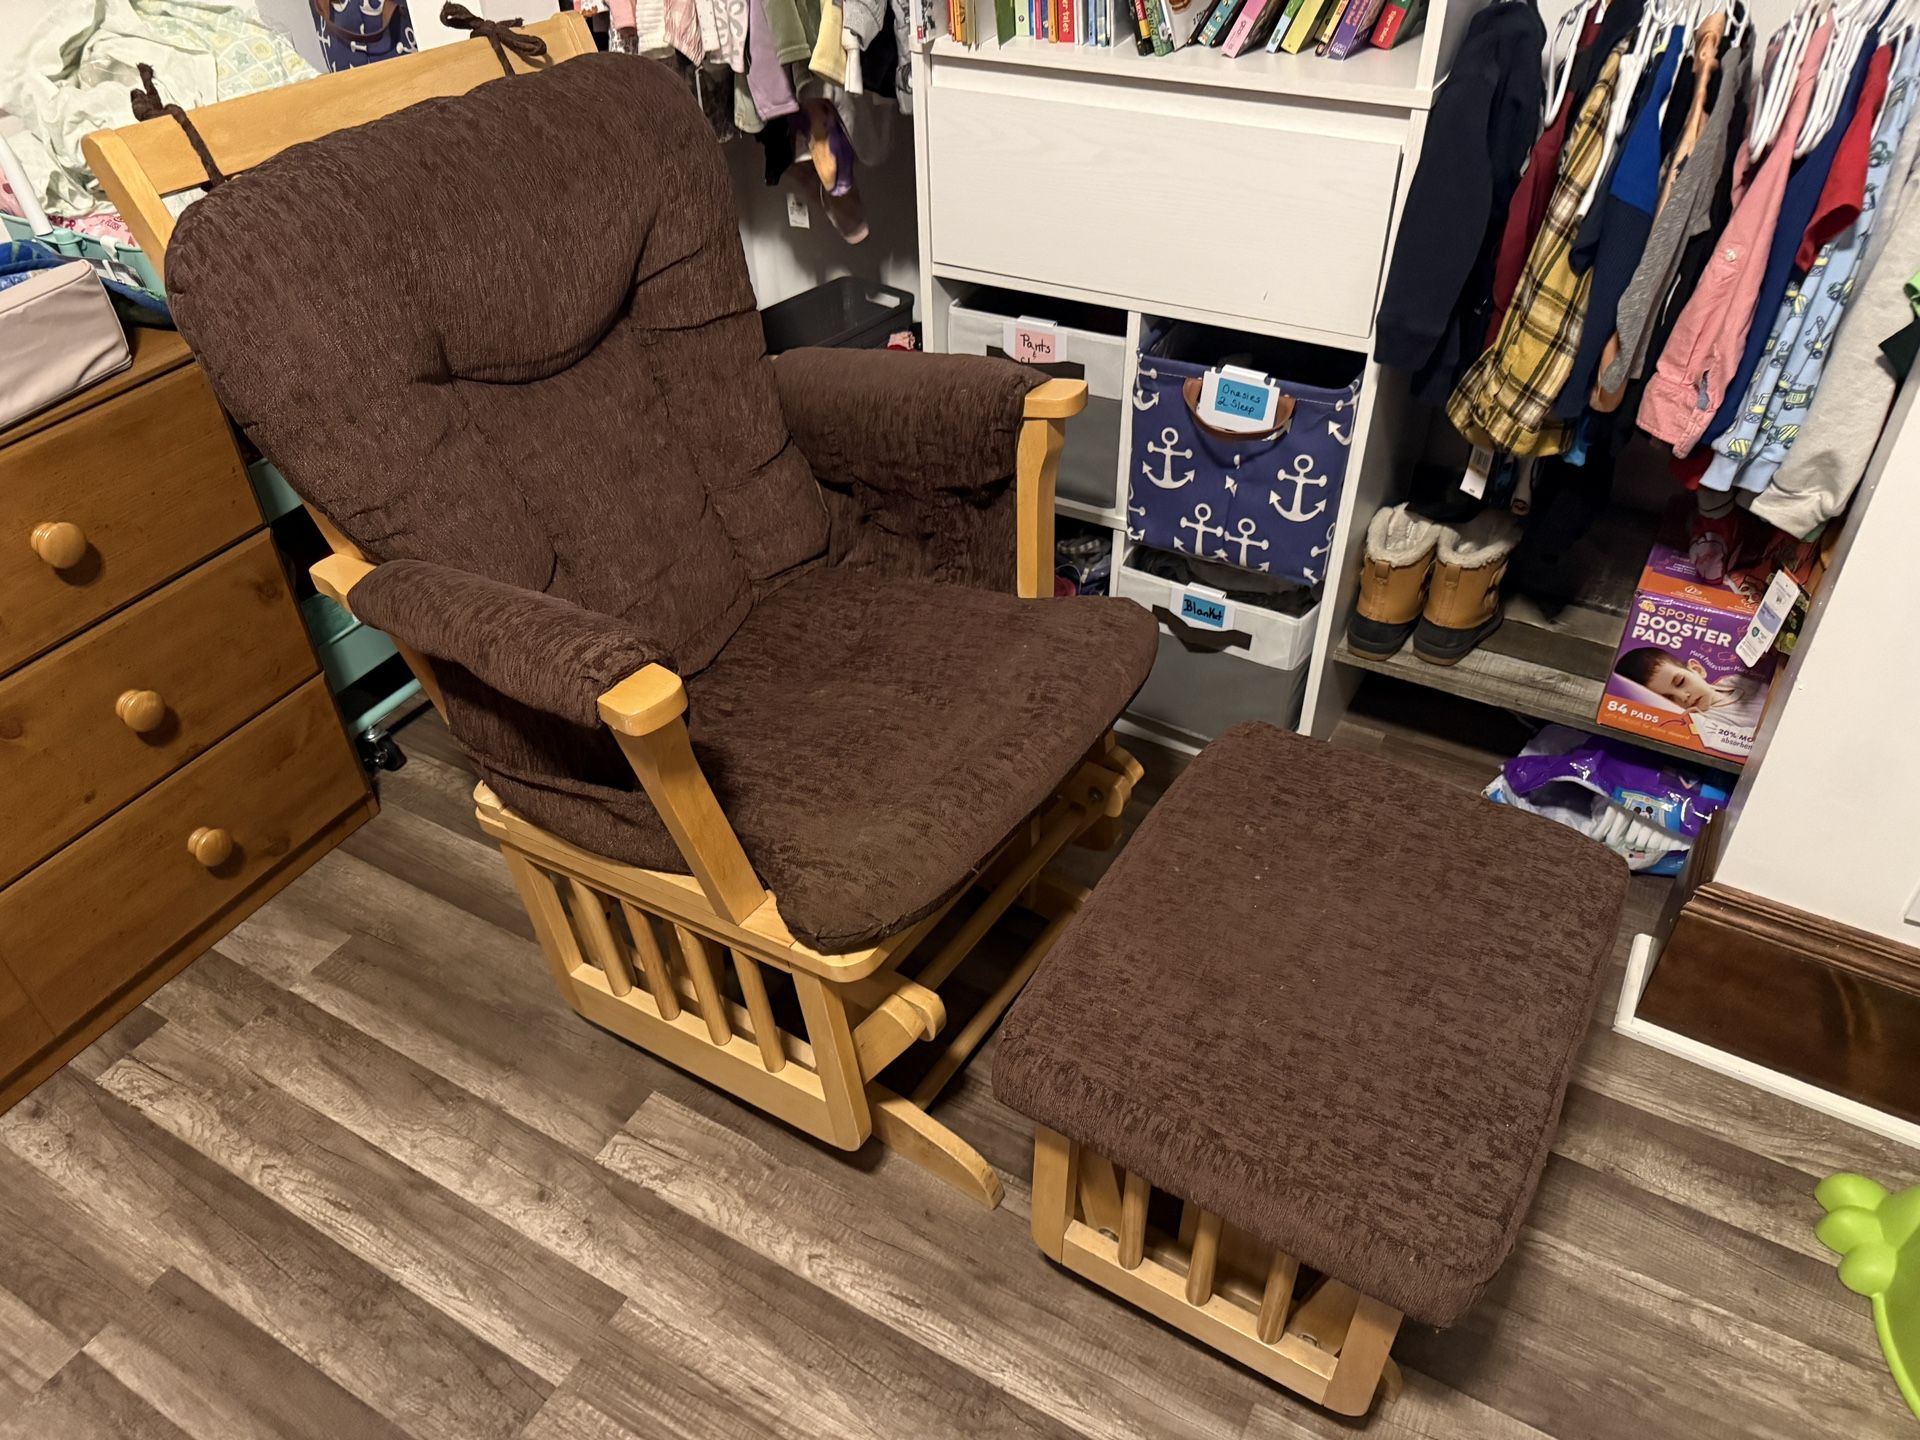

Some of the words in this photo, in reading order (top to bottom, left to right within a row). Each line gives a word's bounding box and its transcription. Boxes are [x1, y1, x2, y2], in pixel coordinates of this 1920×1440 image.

[1020, 333, 1051, 354] Pants
[1222, 384, 1261, 404] Onesies
[1657, 606, 1710, 627] SPOSIE
[1631, 625, 1683, 650] PADS
[1636, 612, 1732, 648] BOOSTER
[1607, 700, 1628, 715] 84
[1630, 709, 1659, 724] PADS
[1718, 728, 1737, 739] 20%
[1738, 733, 1754, 743] MO
[1720, 738, 1753, 751] absorben
